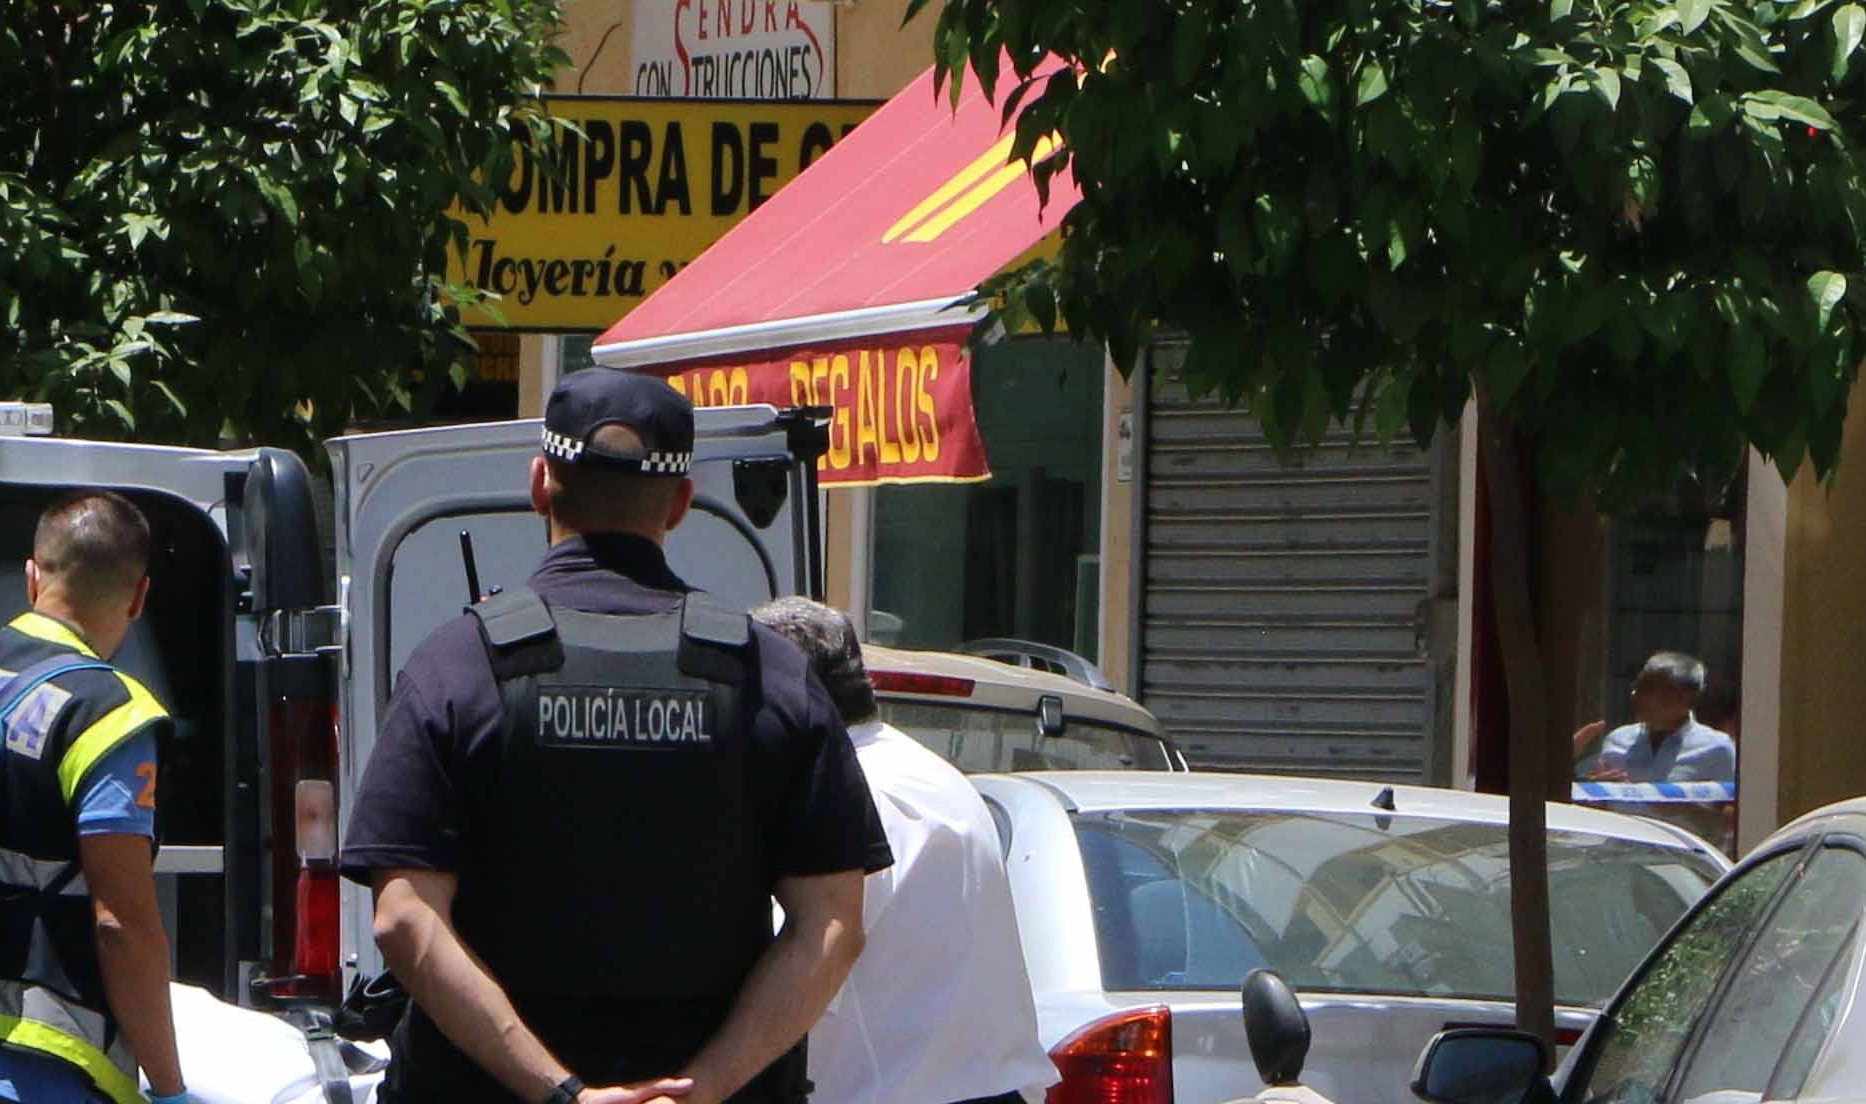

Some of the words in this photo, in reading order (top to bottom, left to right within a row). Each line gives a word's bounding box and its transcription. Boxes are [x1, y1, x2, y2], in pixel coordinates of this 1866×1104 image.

[460, 119, 692, 216] OMPRA
[711, 121, 780, 216] DE
[464, 239, 646, 305] Joyería
[539, 688, 629, 740] POLICÍA
[635, 699, 711, 742] LOCAL
